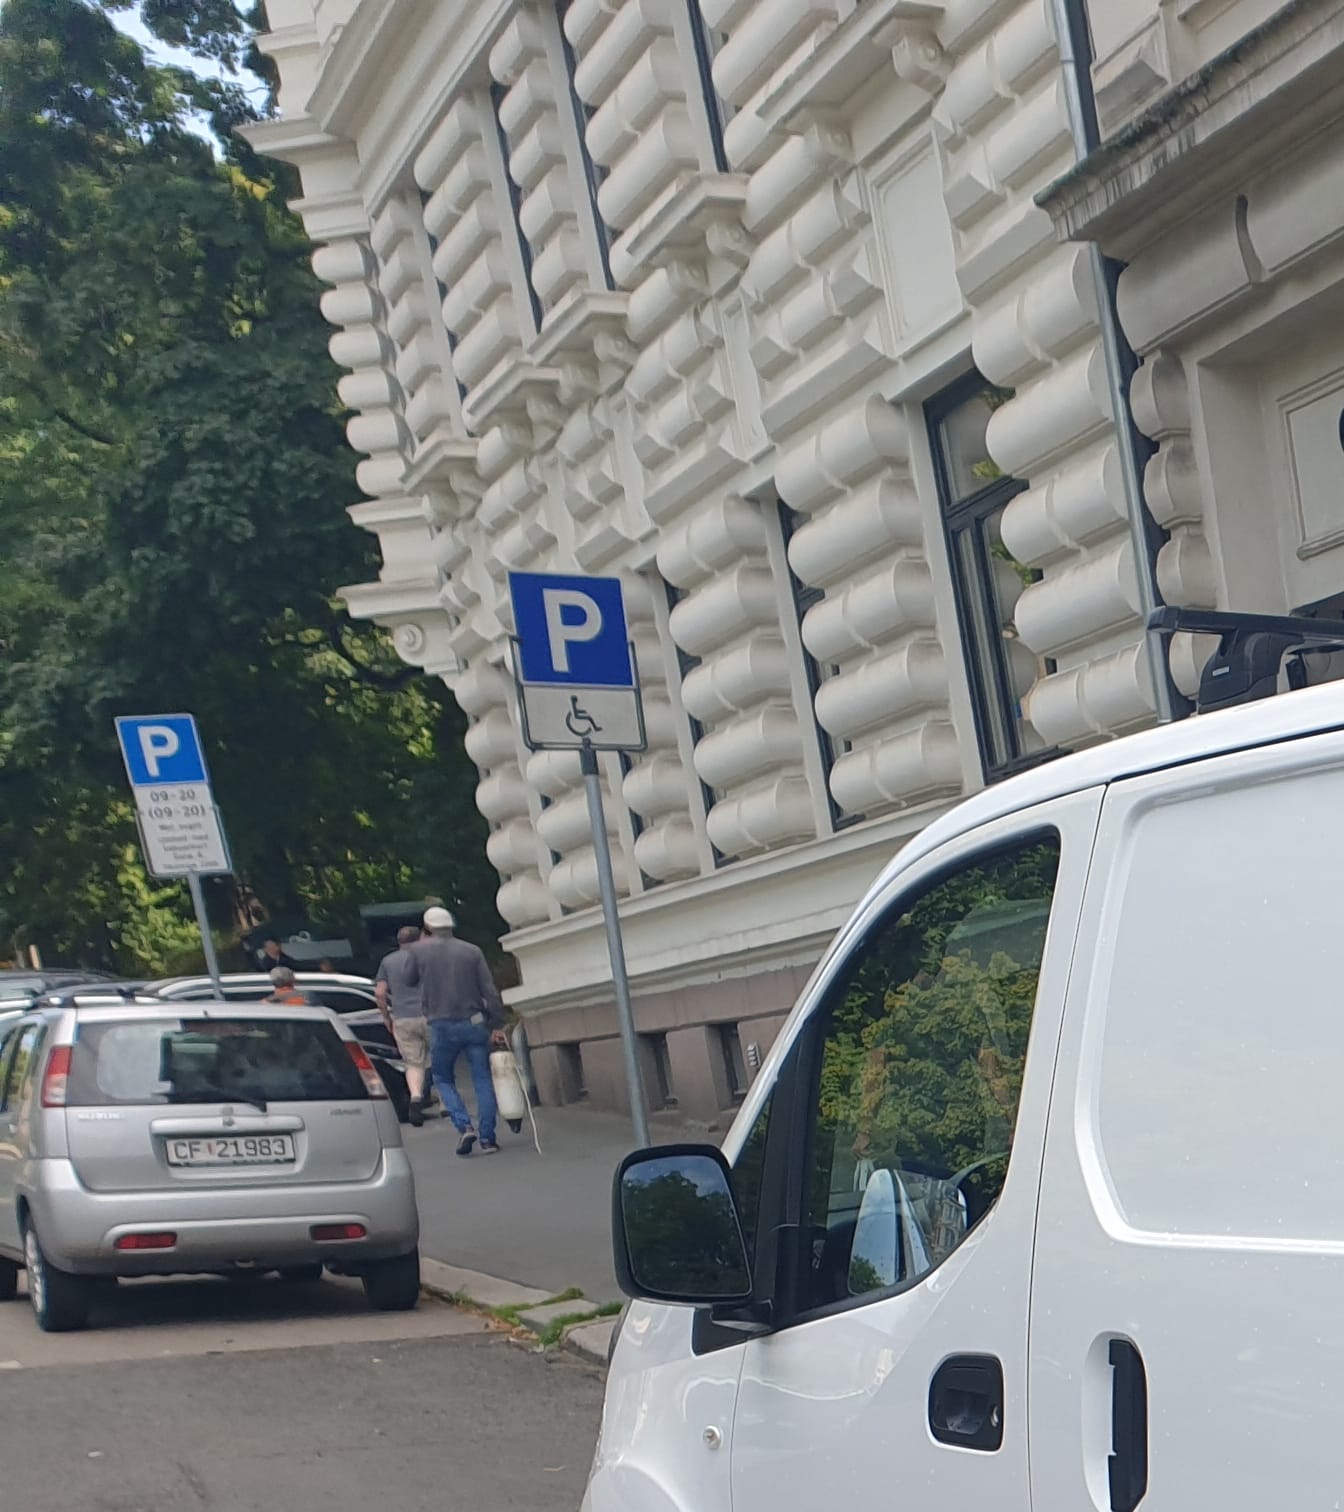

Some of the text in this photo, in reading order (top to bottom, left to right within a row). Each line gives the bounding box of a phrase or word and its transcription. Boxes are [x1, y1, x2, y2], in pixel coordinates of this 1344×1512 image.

[543, 588, 602, 673] P
[137, 725, 179, 777] P
[173, 1138, 286, 1160] CF 21983
